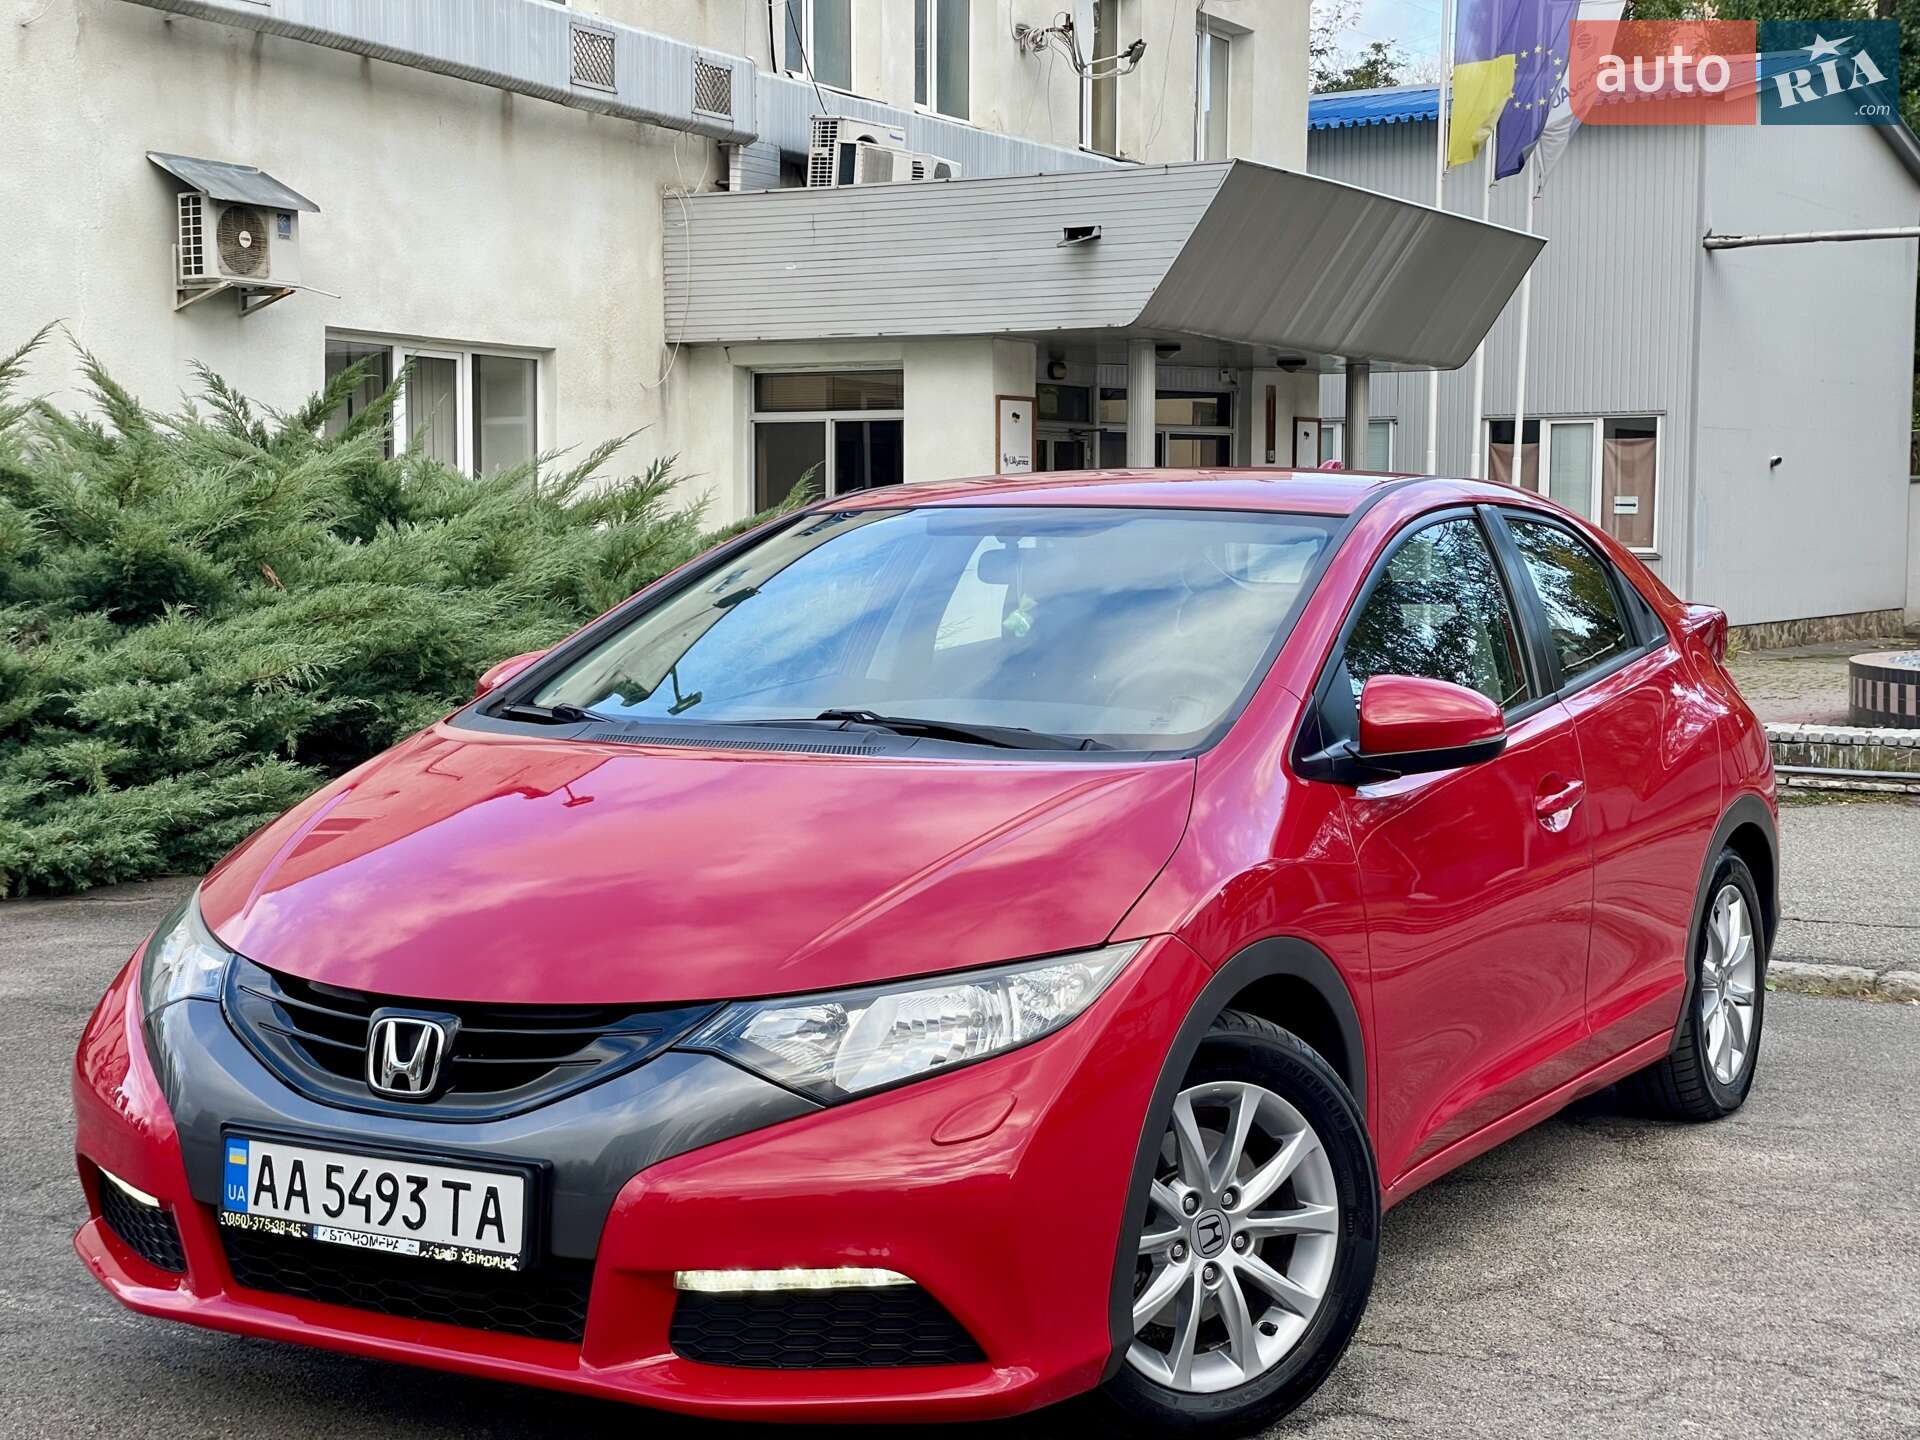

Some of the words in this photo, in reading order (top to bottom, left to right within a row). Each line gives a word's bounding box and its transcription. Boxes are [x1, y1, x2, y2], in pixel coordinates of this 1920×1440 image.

[228, 1186, 246, 1203] UA
[253, 1154, 310, 1214] AA
[321, 1164, 429, 1231] 5493
[441, 1179, 506, 1244] TA
